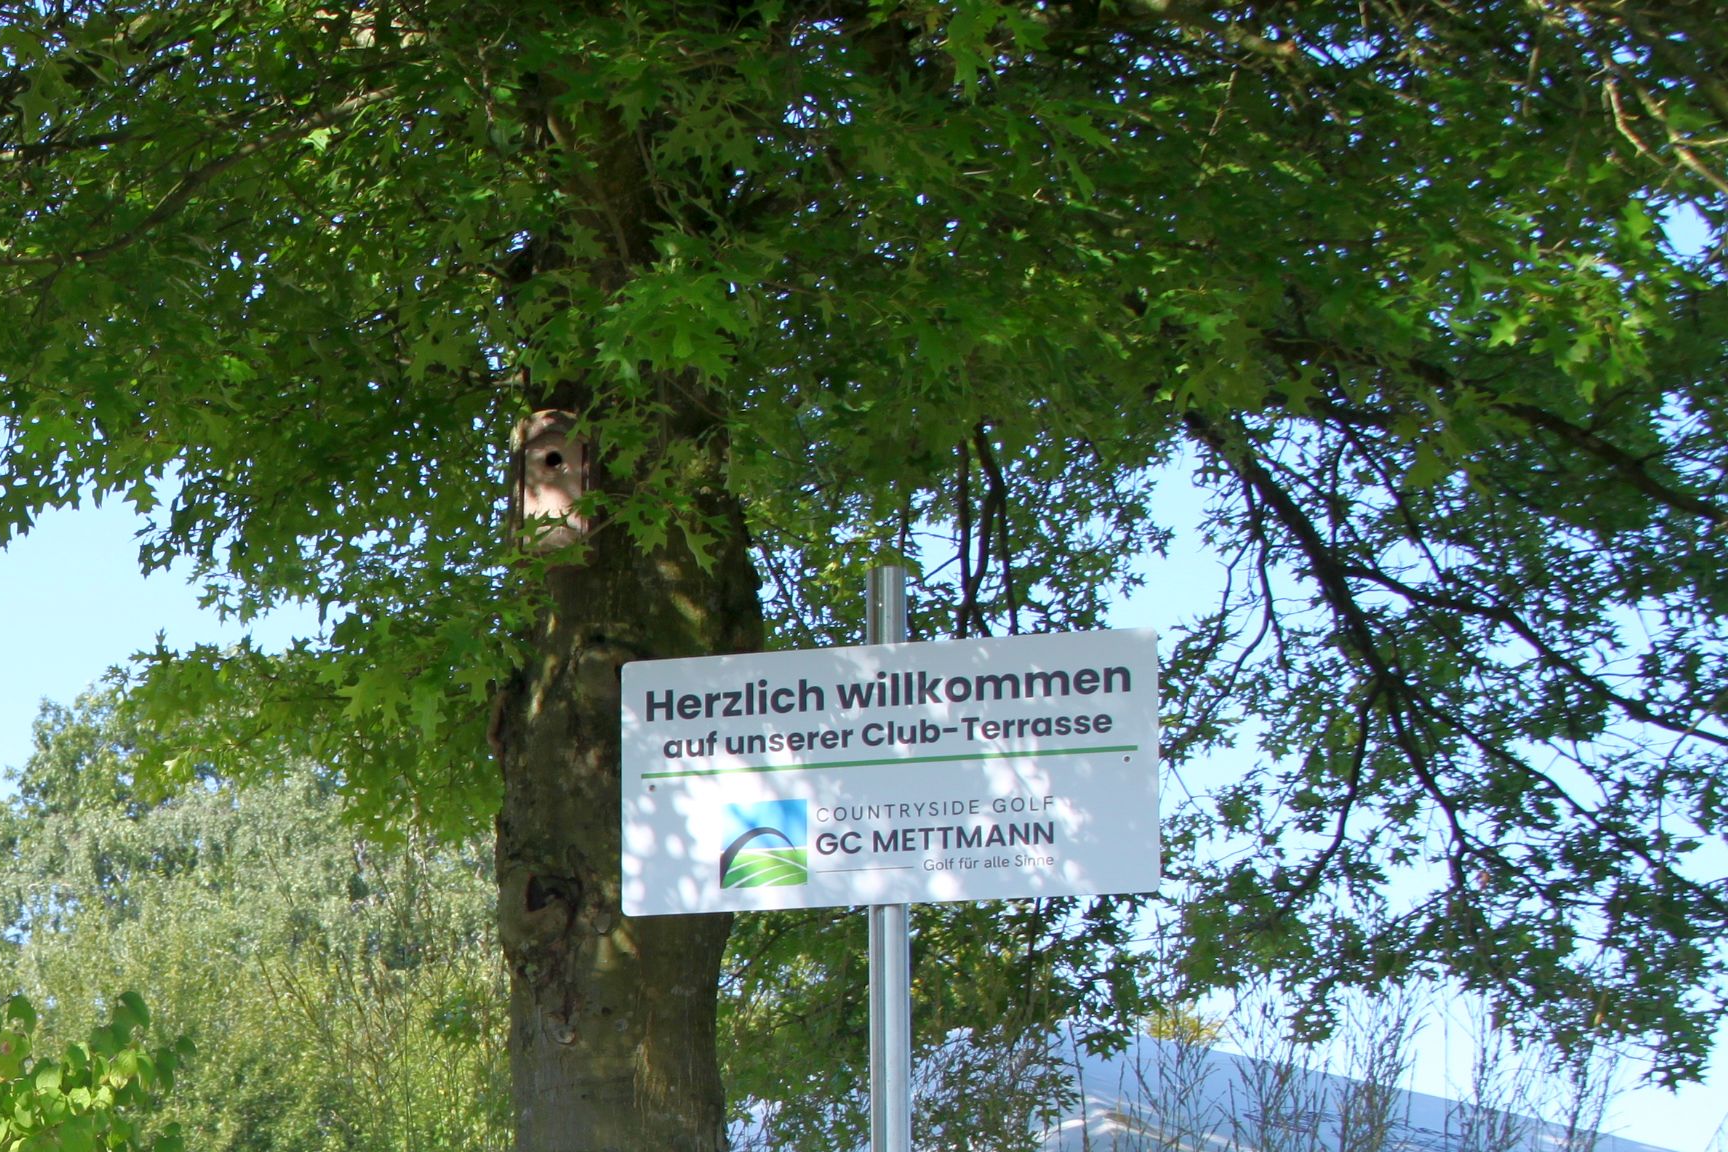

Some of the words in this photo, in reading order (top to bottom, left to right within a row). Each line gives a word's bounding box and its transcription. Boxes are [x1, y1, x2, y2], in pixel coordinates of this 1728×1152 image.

[645, 679, 825, 722] Herzlich
[836, 665, 1131, 710] willkommen
[663, 731, 718, 759] auf
[725, 729, 854, 756] unserer
[861, 713, 1113, 746] Club-Terrasse
[816, 799, 980, 823] COUNTRYSIDE
[992, 795, 1055, 813] GOLF
[815, 831, 862, 856] GC
[872, 821, 1055, 853] METTMANN
[923, 858, 954, 872] Golf
[958, 857, 980, 870] für
[984, 856, 1010, 869] alle
[1014, 853, 1055, 868] Sinne
